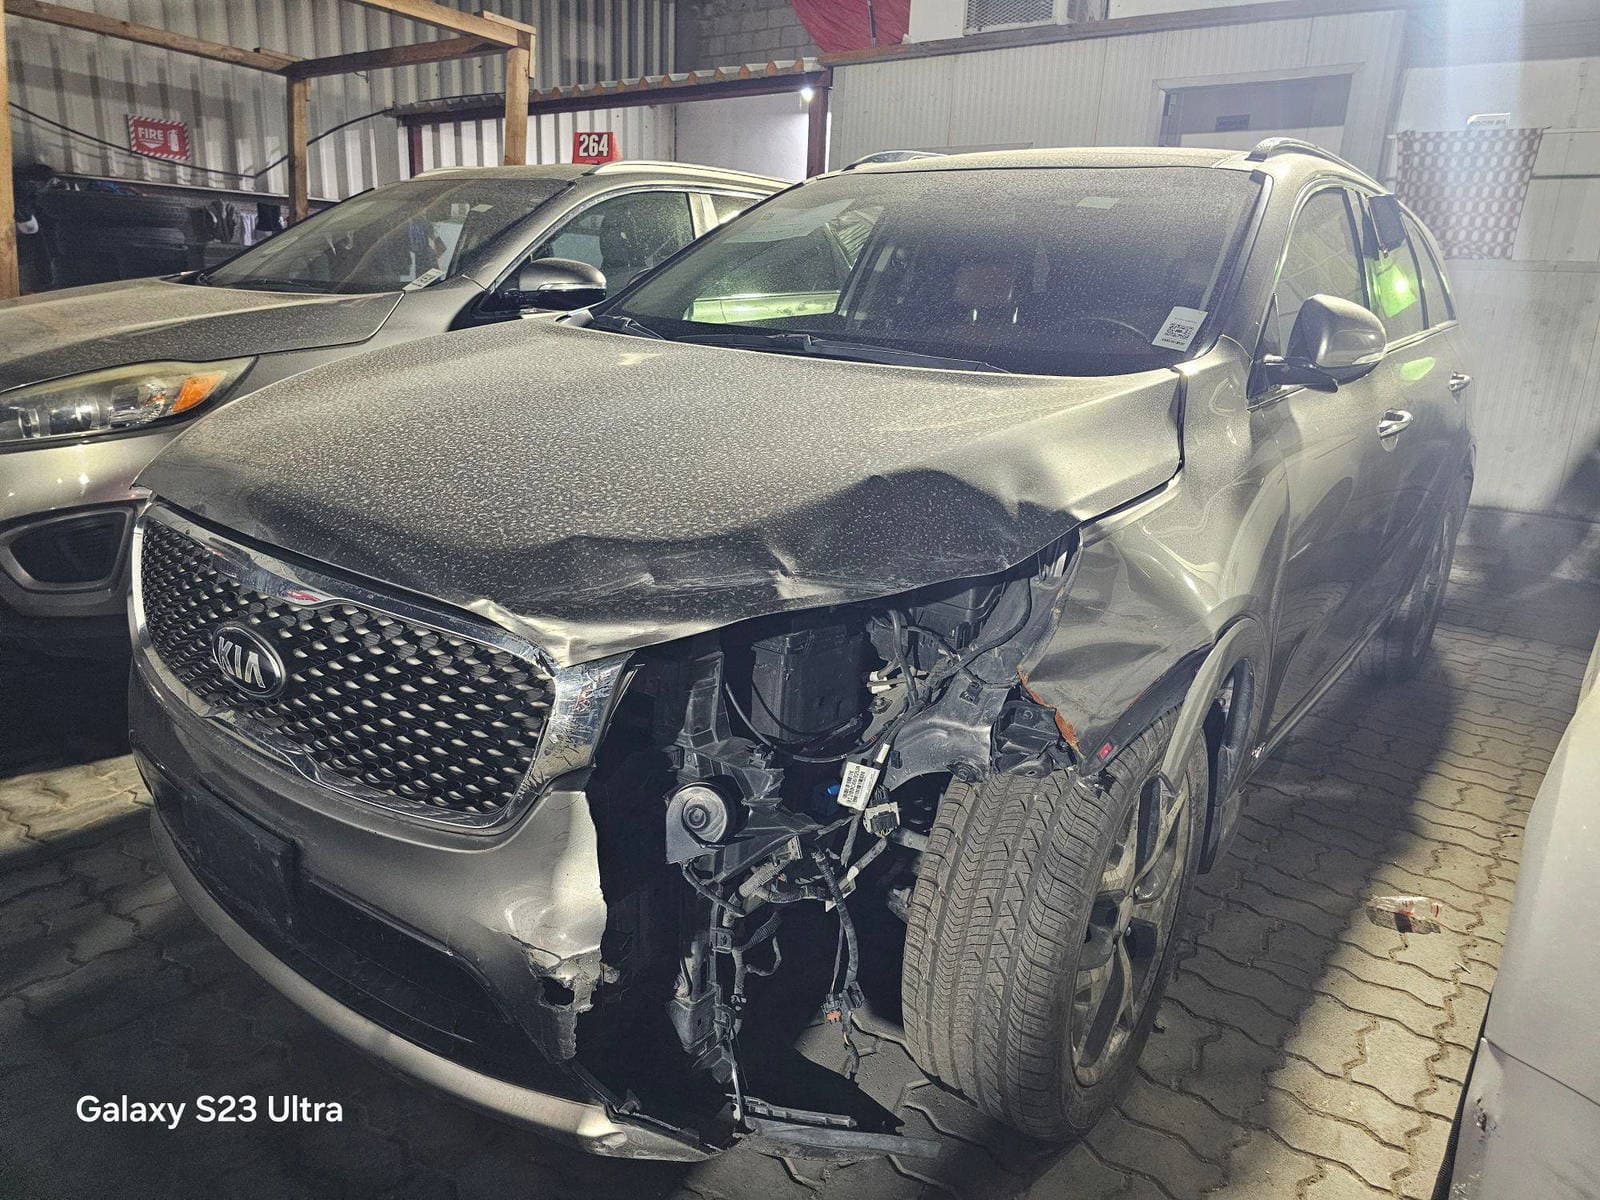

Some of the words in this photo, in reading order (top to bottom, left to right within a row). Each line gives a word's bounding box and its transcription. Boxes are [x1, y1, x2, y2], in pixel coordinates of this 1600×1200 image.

[138, 127, 164, 140] FIRE
[578, 134, 608, 157] 264
[218, 636, 266, 688] KIA
